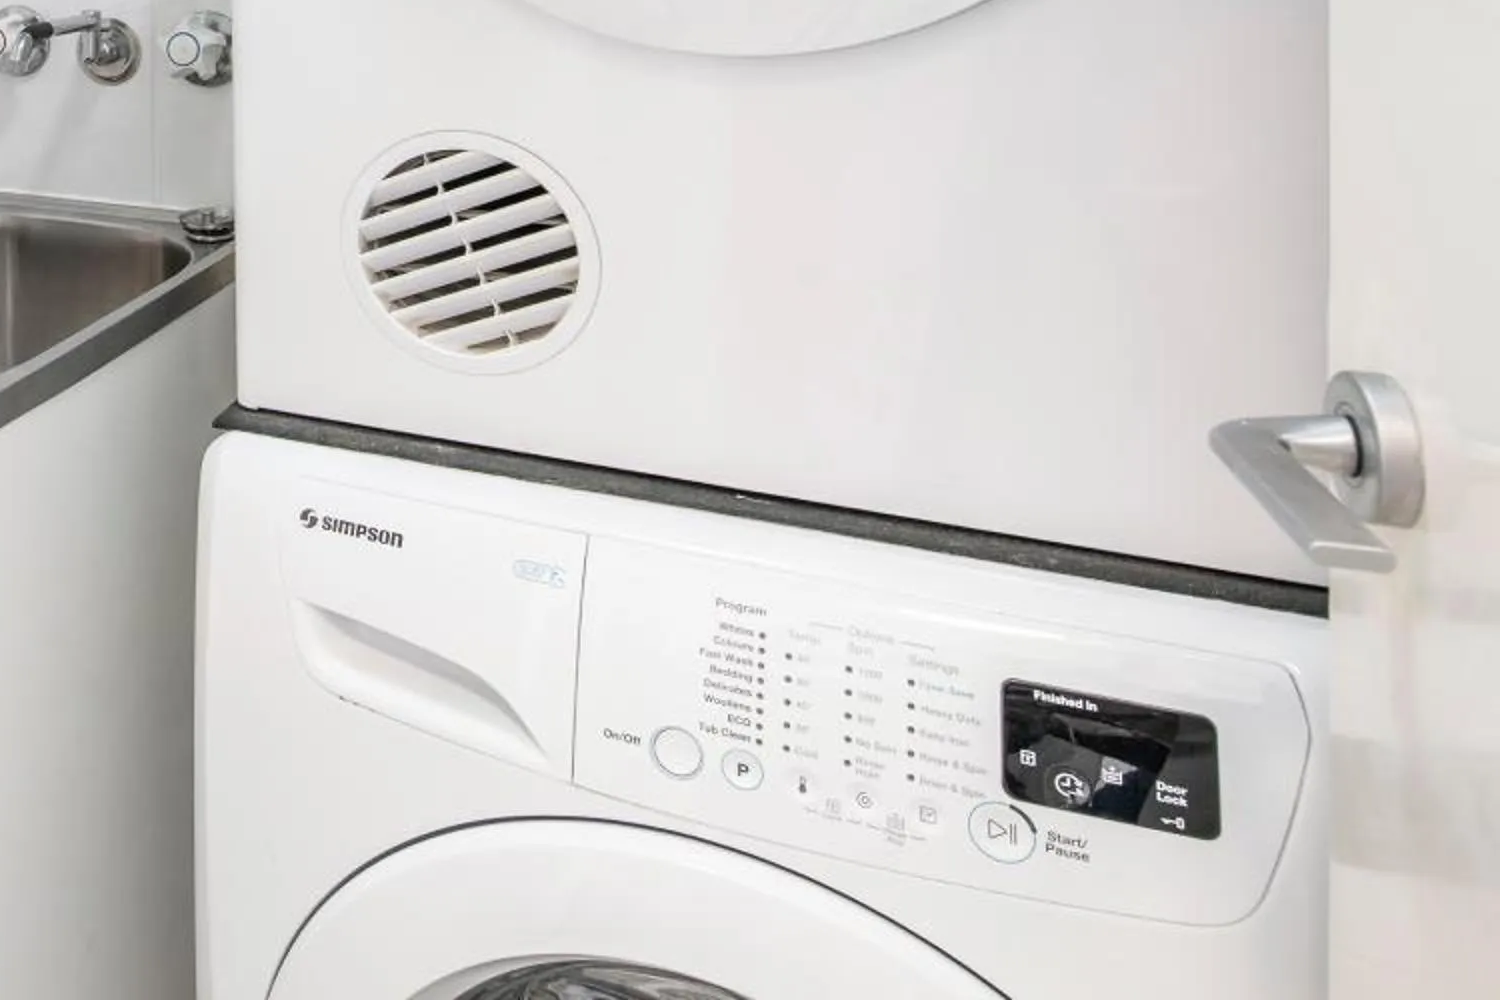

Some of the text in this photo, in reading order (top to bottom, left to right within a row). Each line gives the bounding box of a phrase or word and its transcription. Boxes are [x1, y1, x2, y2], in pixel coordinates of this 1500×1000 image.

[321, 516, 404, 549] SIMPSON
[715, 597, 767, 617] Program
[1033, 689, 1083, 710] Finished
[700, 721, 719, 735] Tub
[727, 713, 751, 727] ECO
[603, 728, 641, 746] On/Off
[737, 763, 749, 777] P
[1155, 780, 1188, 797] Door
[1155, 791, 1188, 808] Lock
[1047, 830, 1088, 849] Start/
[1045, 843, 1091, 863] Pause
